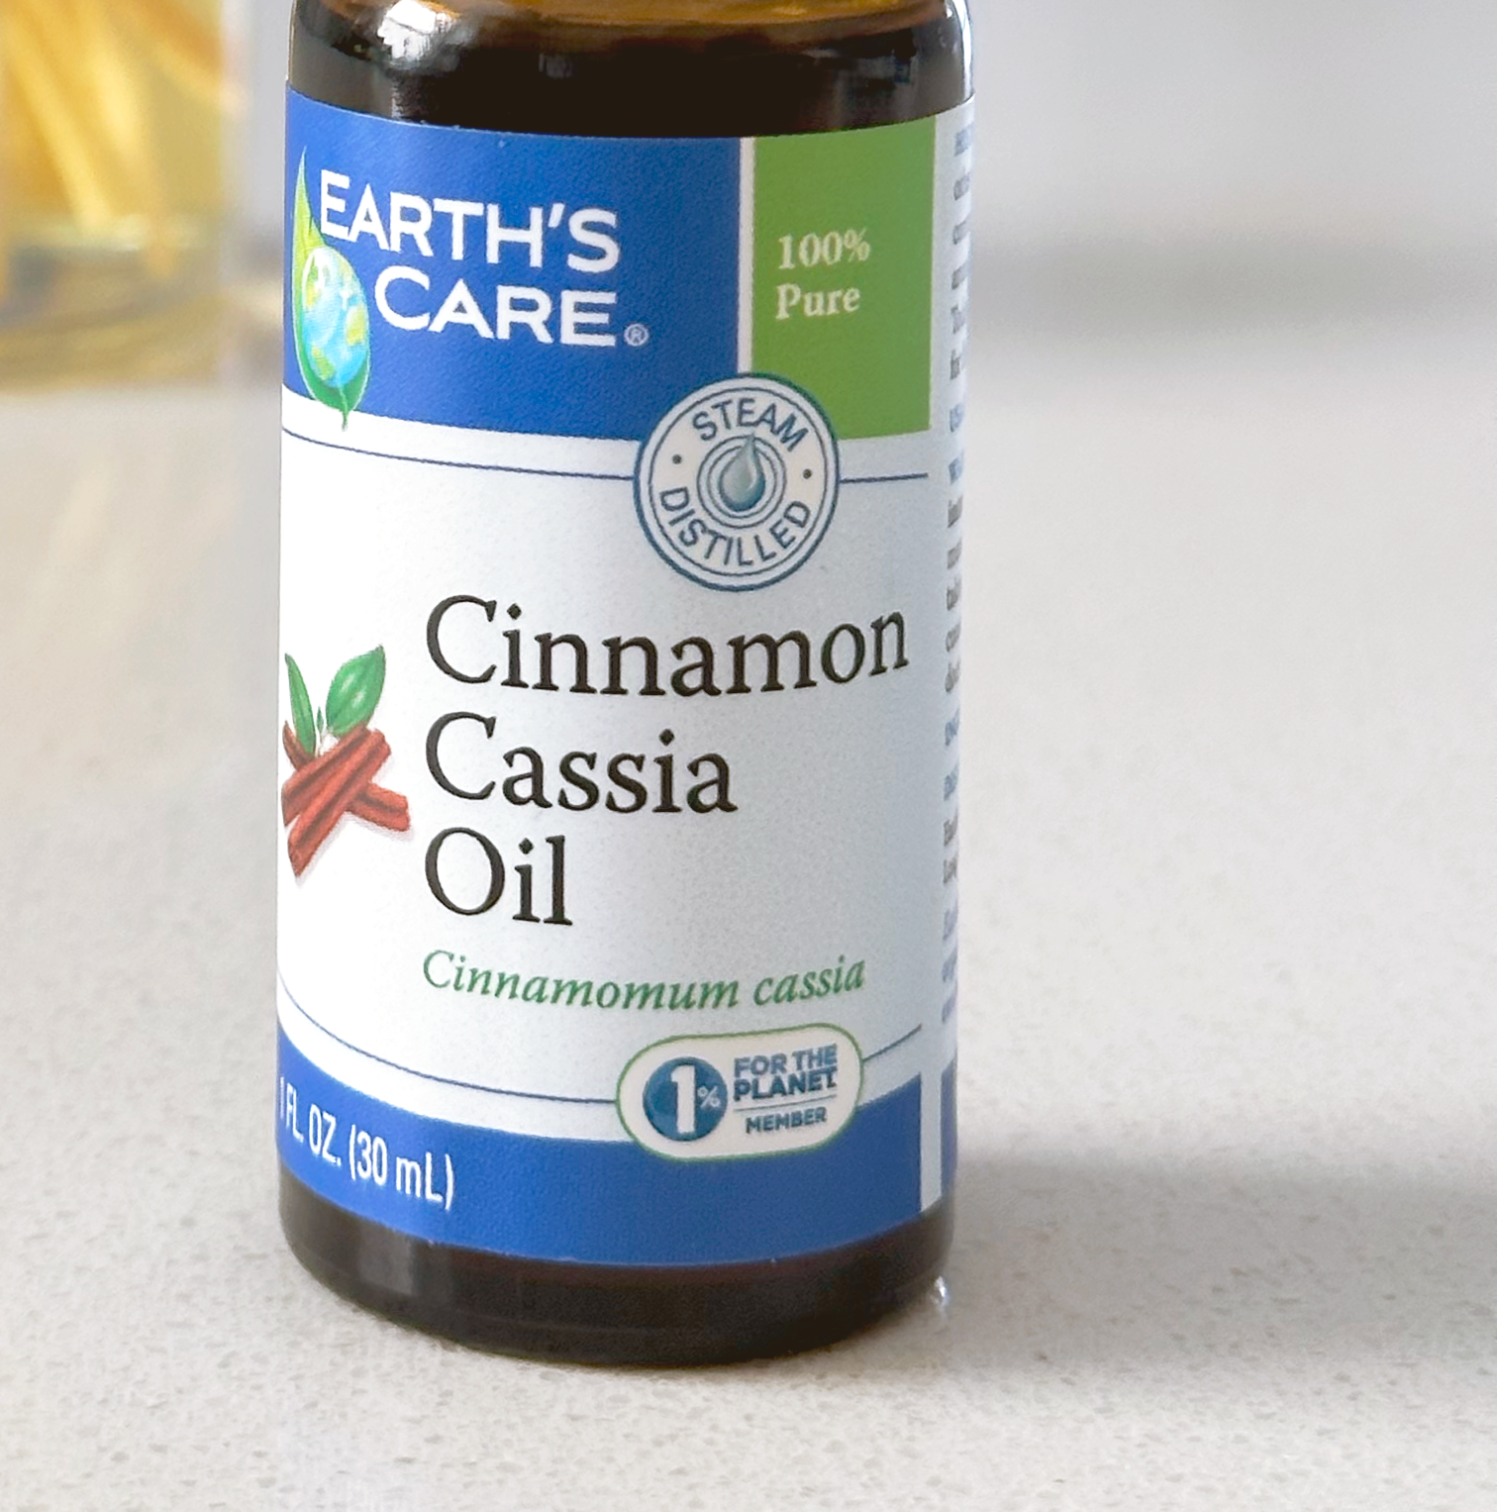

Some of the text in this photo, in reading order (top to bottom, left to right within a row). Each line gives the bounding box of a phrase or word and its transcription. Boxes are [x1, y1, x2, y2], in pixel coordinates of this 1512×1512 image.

[320, 169, 620, 273] EARTH'S
[778, 227, 871, 270] 100%
[775, 283, 861, 320] Pure
[692, 397, 809, 452] STEAM
[659, 486, 811, 566] DISTILLED
[425, 594, 910, 697] Cinnamon
[425, 711, 739, 814] Cassia
[424, 826, 574, 927] Oil
[422, 949, 866, 1010] Cinnamomum cassia
[733, 1043, 838, 1078] FOR THE
[733, 1066, 838, 1102] PLANET
[670, 1064, 722, 1135] 1%
[745, 1106, 827, 1135] MEMBER
[308, 1104, 342, 1167] OZ.
[349, 1124, 388, 1186] (30
[395, 1152, 455, 1212] mL)
